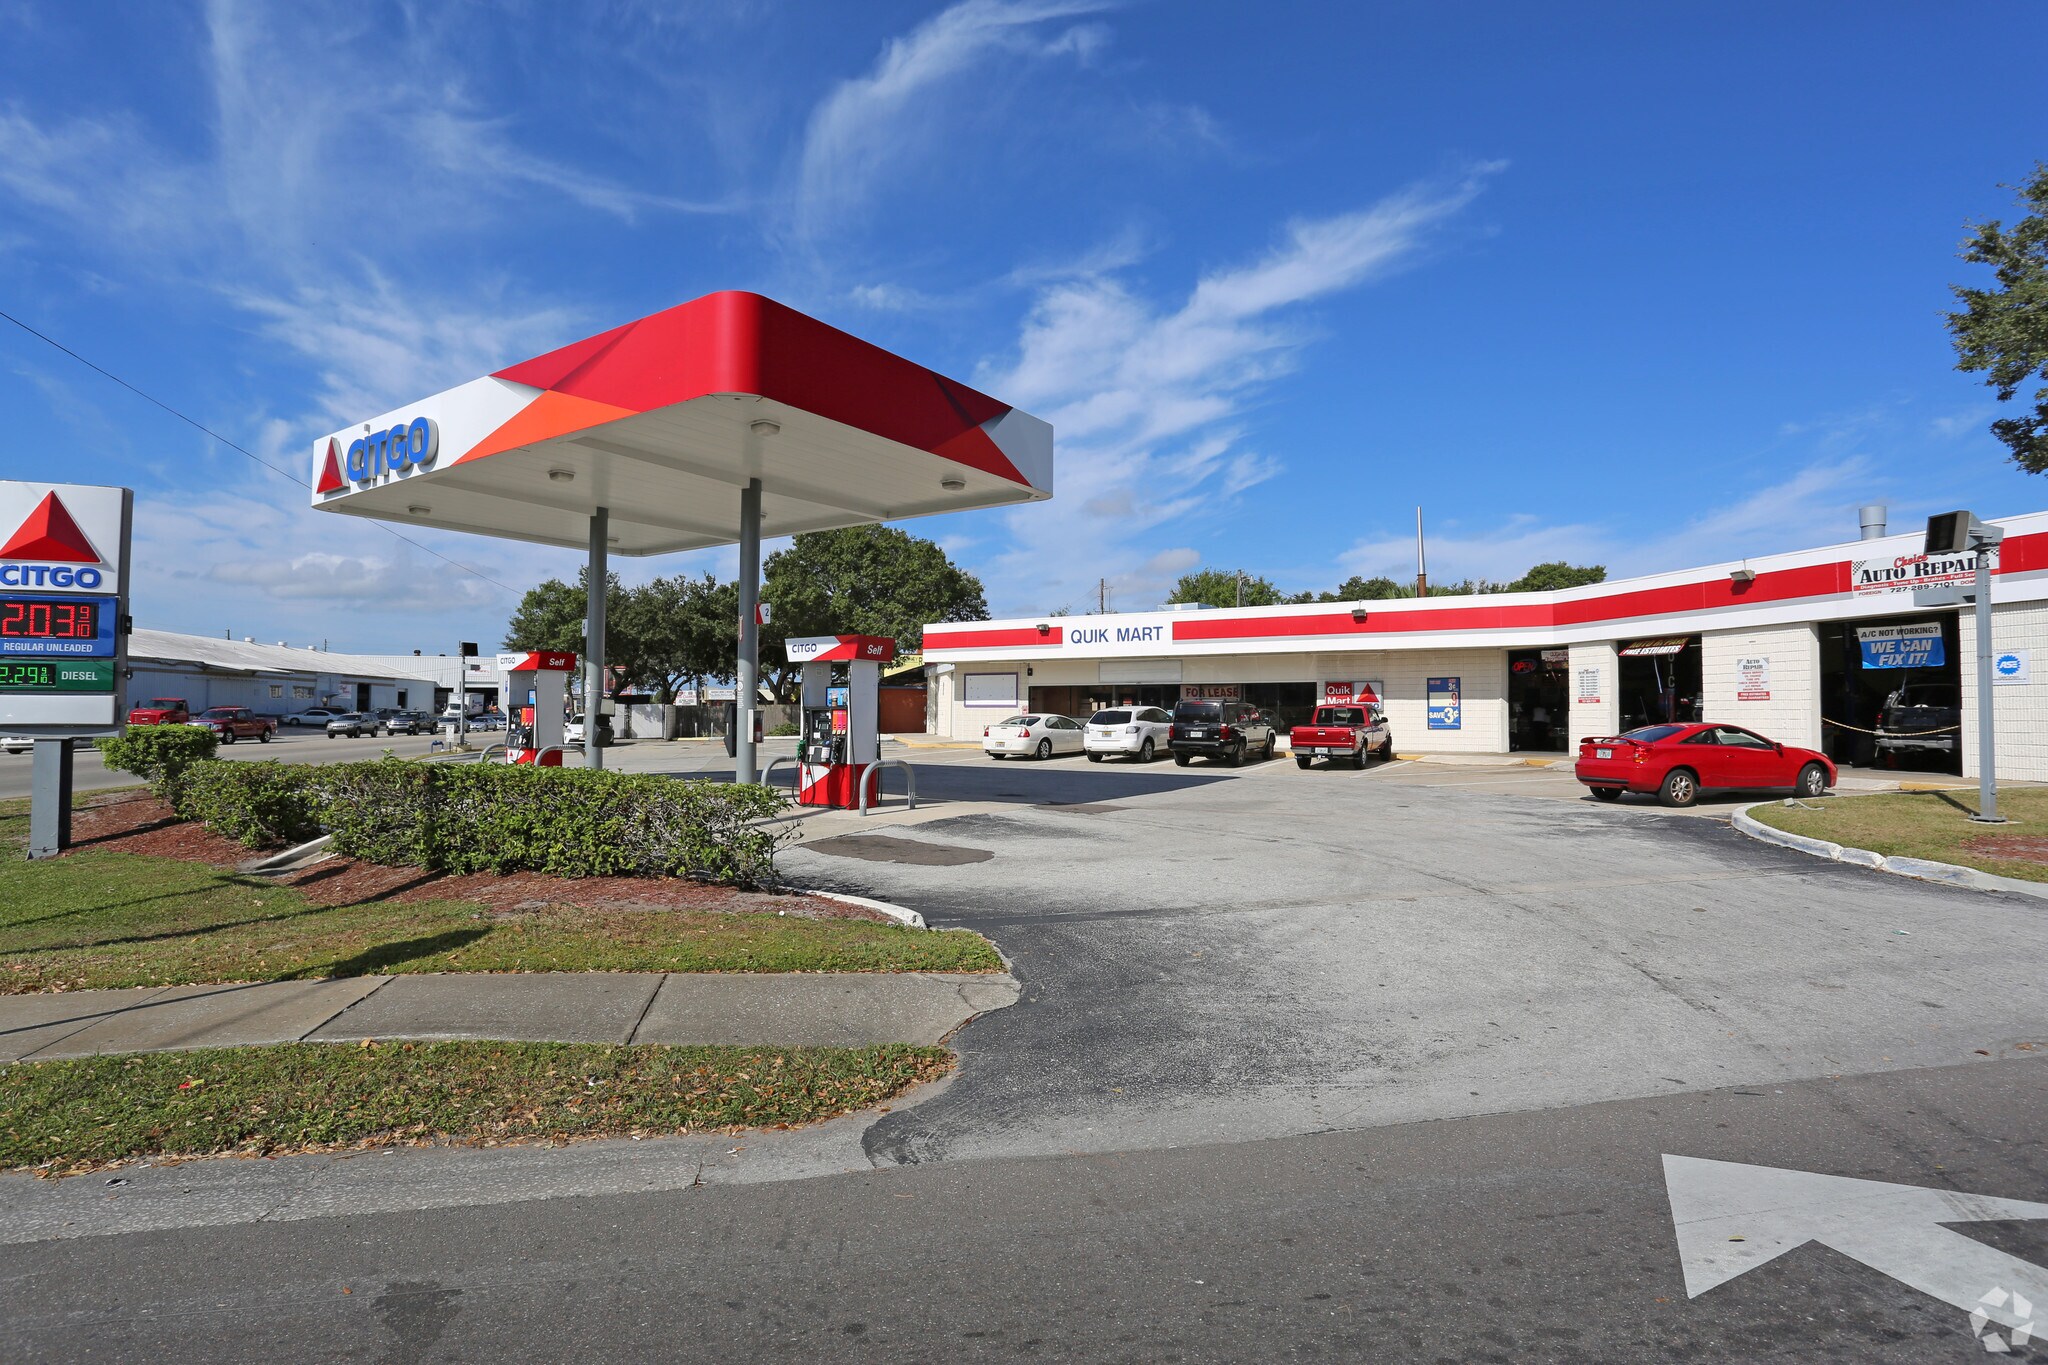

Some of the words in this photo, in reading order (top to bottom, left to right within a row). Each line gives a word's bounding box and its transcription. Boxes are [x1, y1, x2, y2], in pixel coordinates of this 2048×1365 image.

[347, 417, 434, 481] CITGO
[1893, 554, 1928, 568] Choice
[0, 565, 101, 589] CITGO
[1860, 567, 1906, 583] AUTO
[1071, 629, 1109, 643] QUIK
[1117, 626, 1163, 642] MART
[1878, 629, 1894, 637] NOT
[1896, 626, 1938, 636] WORKING?
[4, 643, 44, 652] REGULAR
[46, 644, 93, 653] UNLEADED
[792, 643, 818, 653] CITGO
[867, 644, 883, 655] Self
[1871, 641, 1896, 654] WE
[1900, 639, 1933, 652] CAN
[500, 657, 516, 665] CITGO
[548, 658, 565, 666] Self
[1878, 653, 1903, 667] FIX
[1907, 652, 1929, 665] IT!
[1999, 660, 2018, 669] ASE
[1512, 661, 1534, 672] OPEN
[61, 671, 98, 681] DIESEL
[1185, 688, 1206, 697] FOR
[1208, 688, 1239, 697] LEASE
[1327, 686, 1350, 695] Quik
